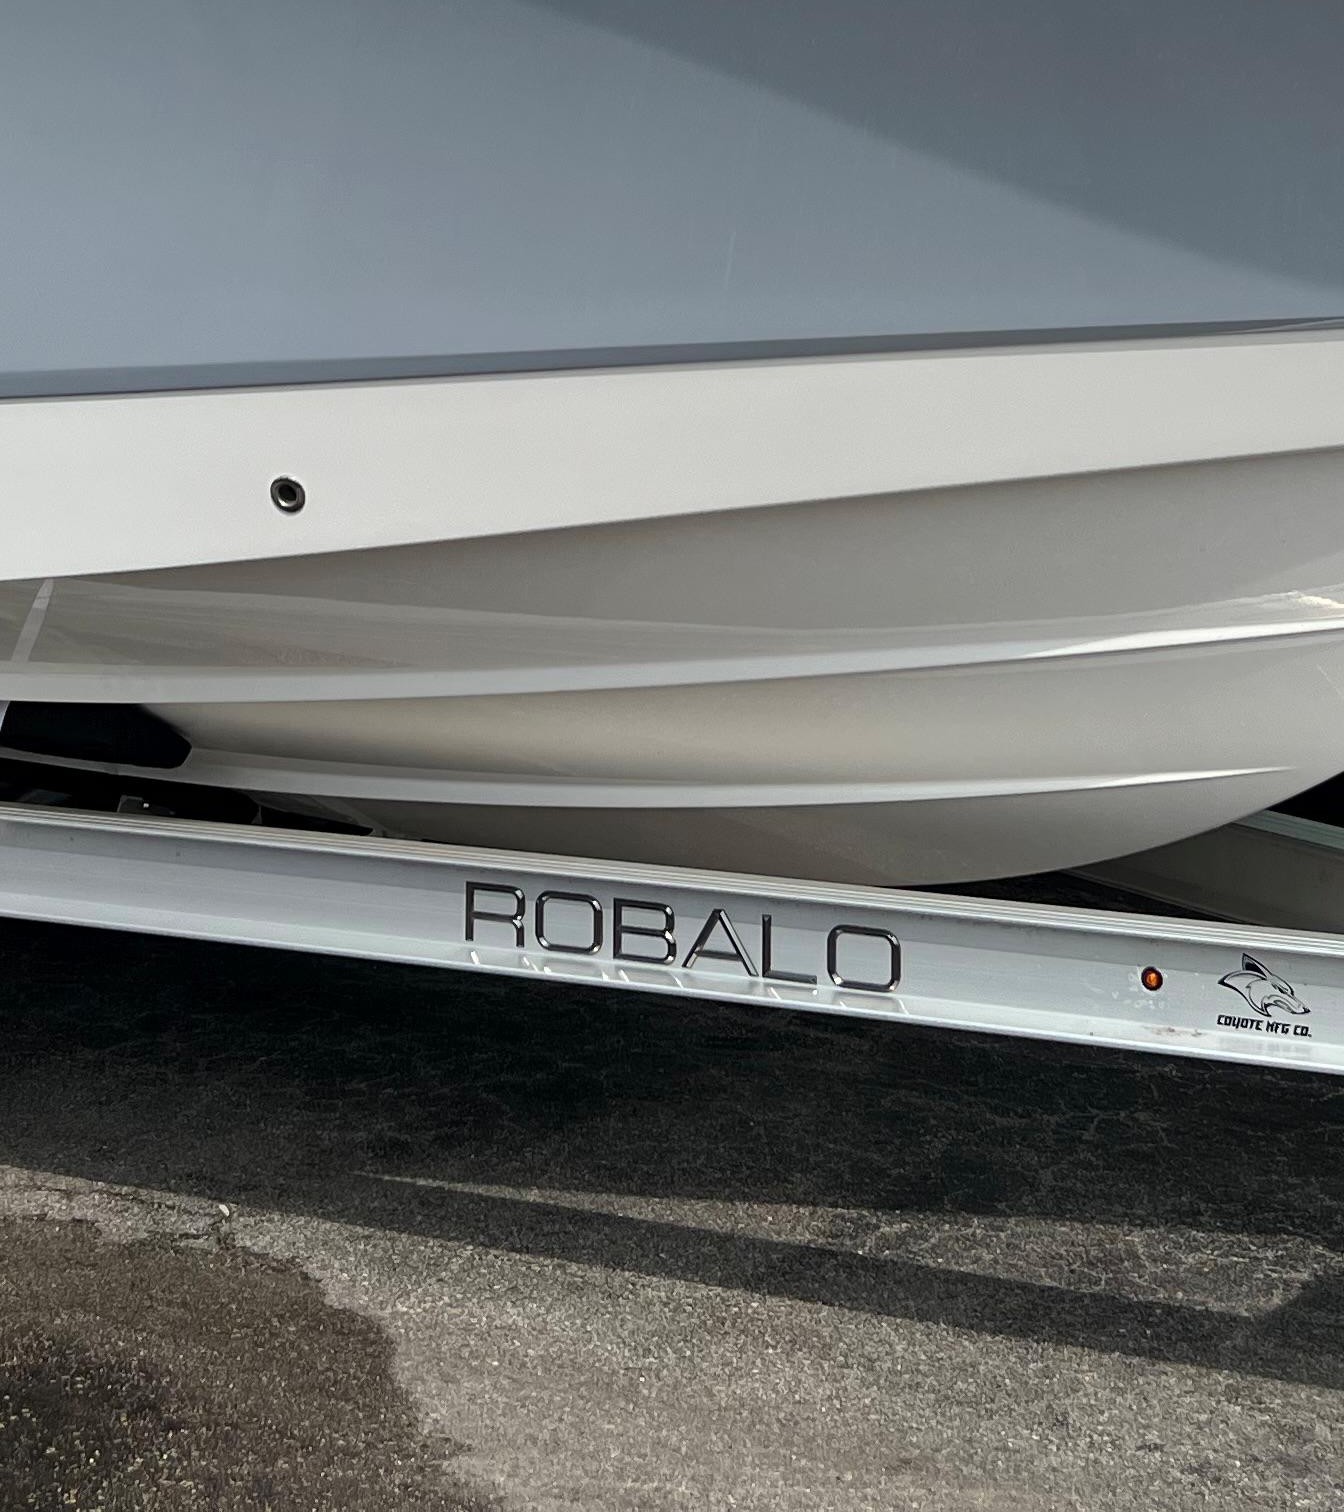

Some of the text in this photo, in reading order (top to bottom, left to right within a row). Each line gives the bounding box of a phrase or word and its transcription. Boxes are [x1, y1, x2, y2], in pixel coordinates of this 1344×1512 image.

[465, 880, 903, 993] ROBALO
[1217, 1014, 1312, 1037] COYOTE MFG CO.
